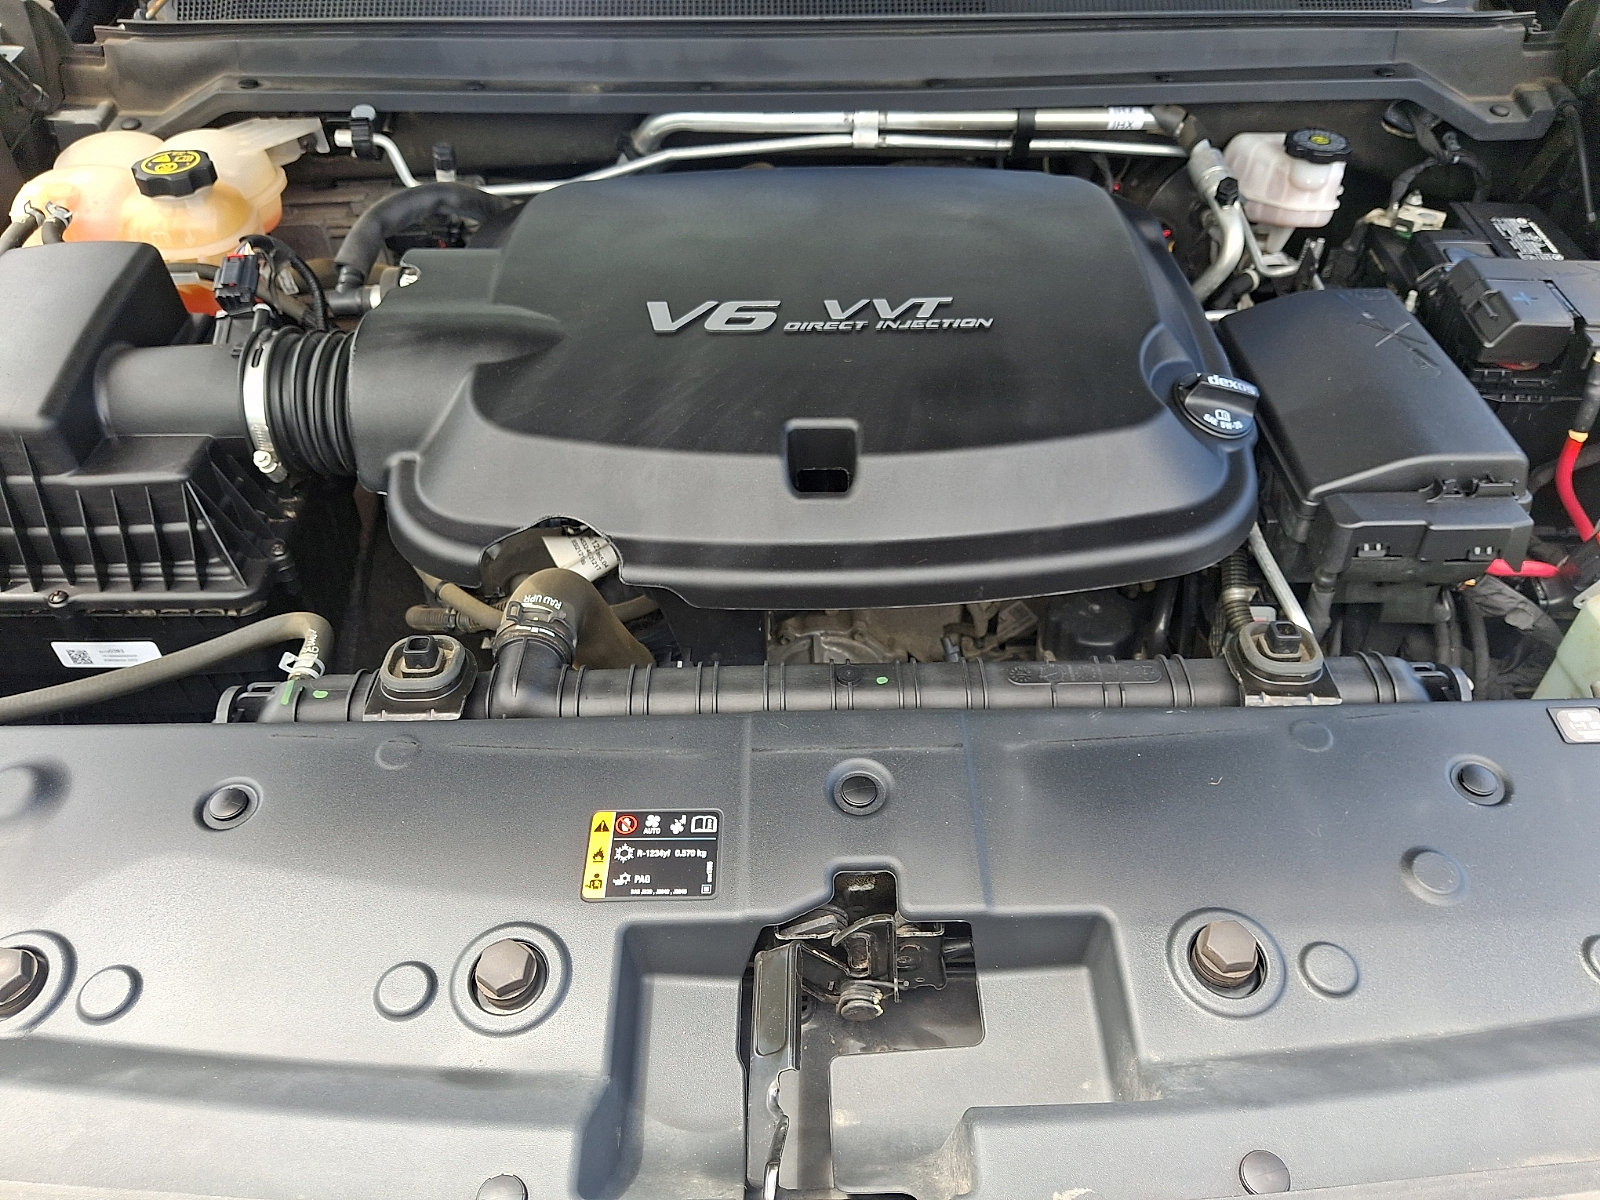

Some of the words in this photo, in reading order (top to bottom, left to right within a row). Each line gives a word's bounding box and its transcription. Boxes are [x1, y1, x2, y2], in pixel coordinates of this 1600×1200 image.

[646, 300, 781, 333] V6
[823, 297, 954, 320] VVT
[783, 320, 869, 333] DIRECT
[875, 317, 994, 331] INJECTION
[523, 594, 543, 603] UPR
[643, 827, 661, 835] AUTO
[674, 849, 696, 858] 0.570
[696, 849, 707, 859] kg
